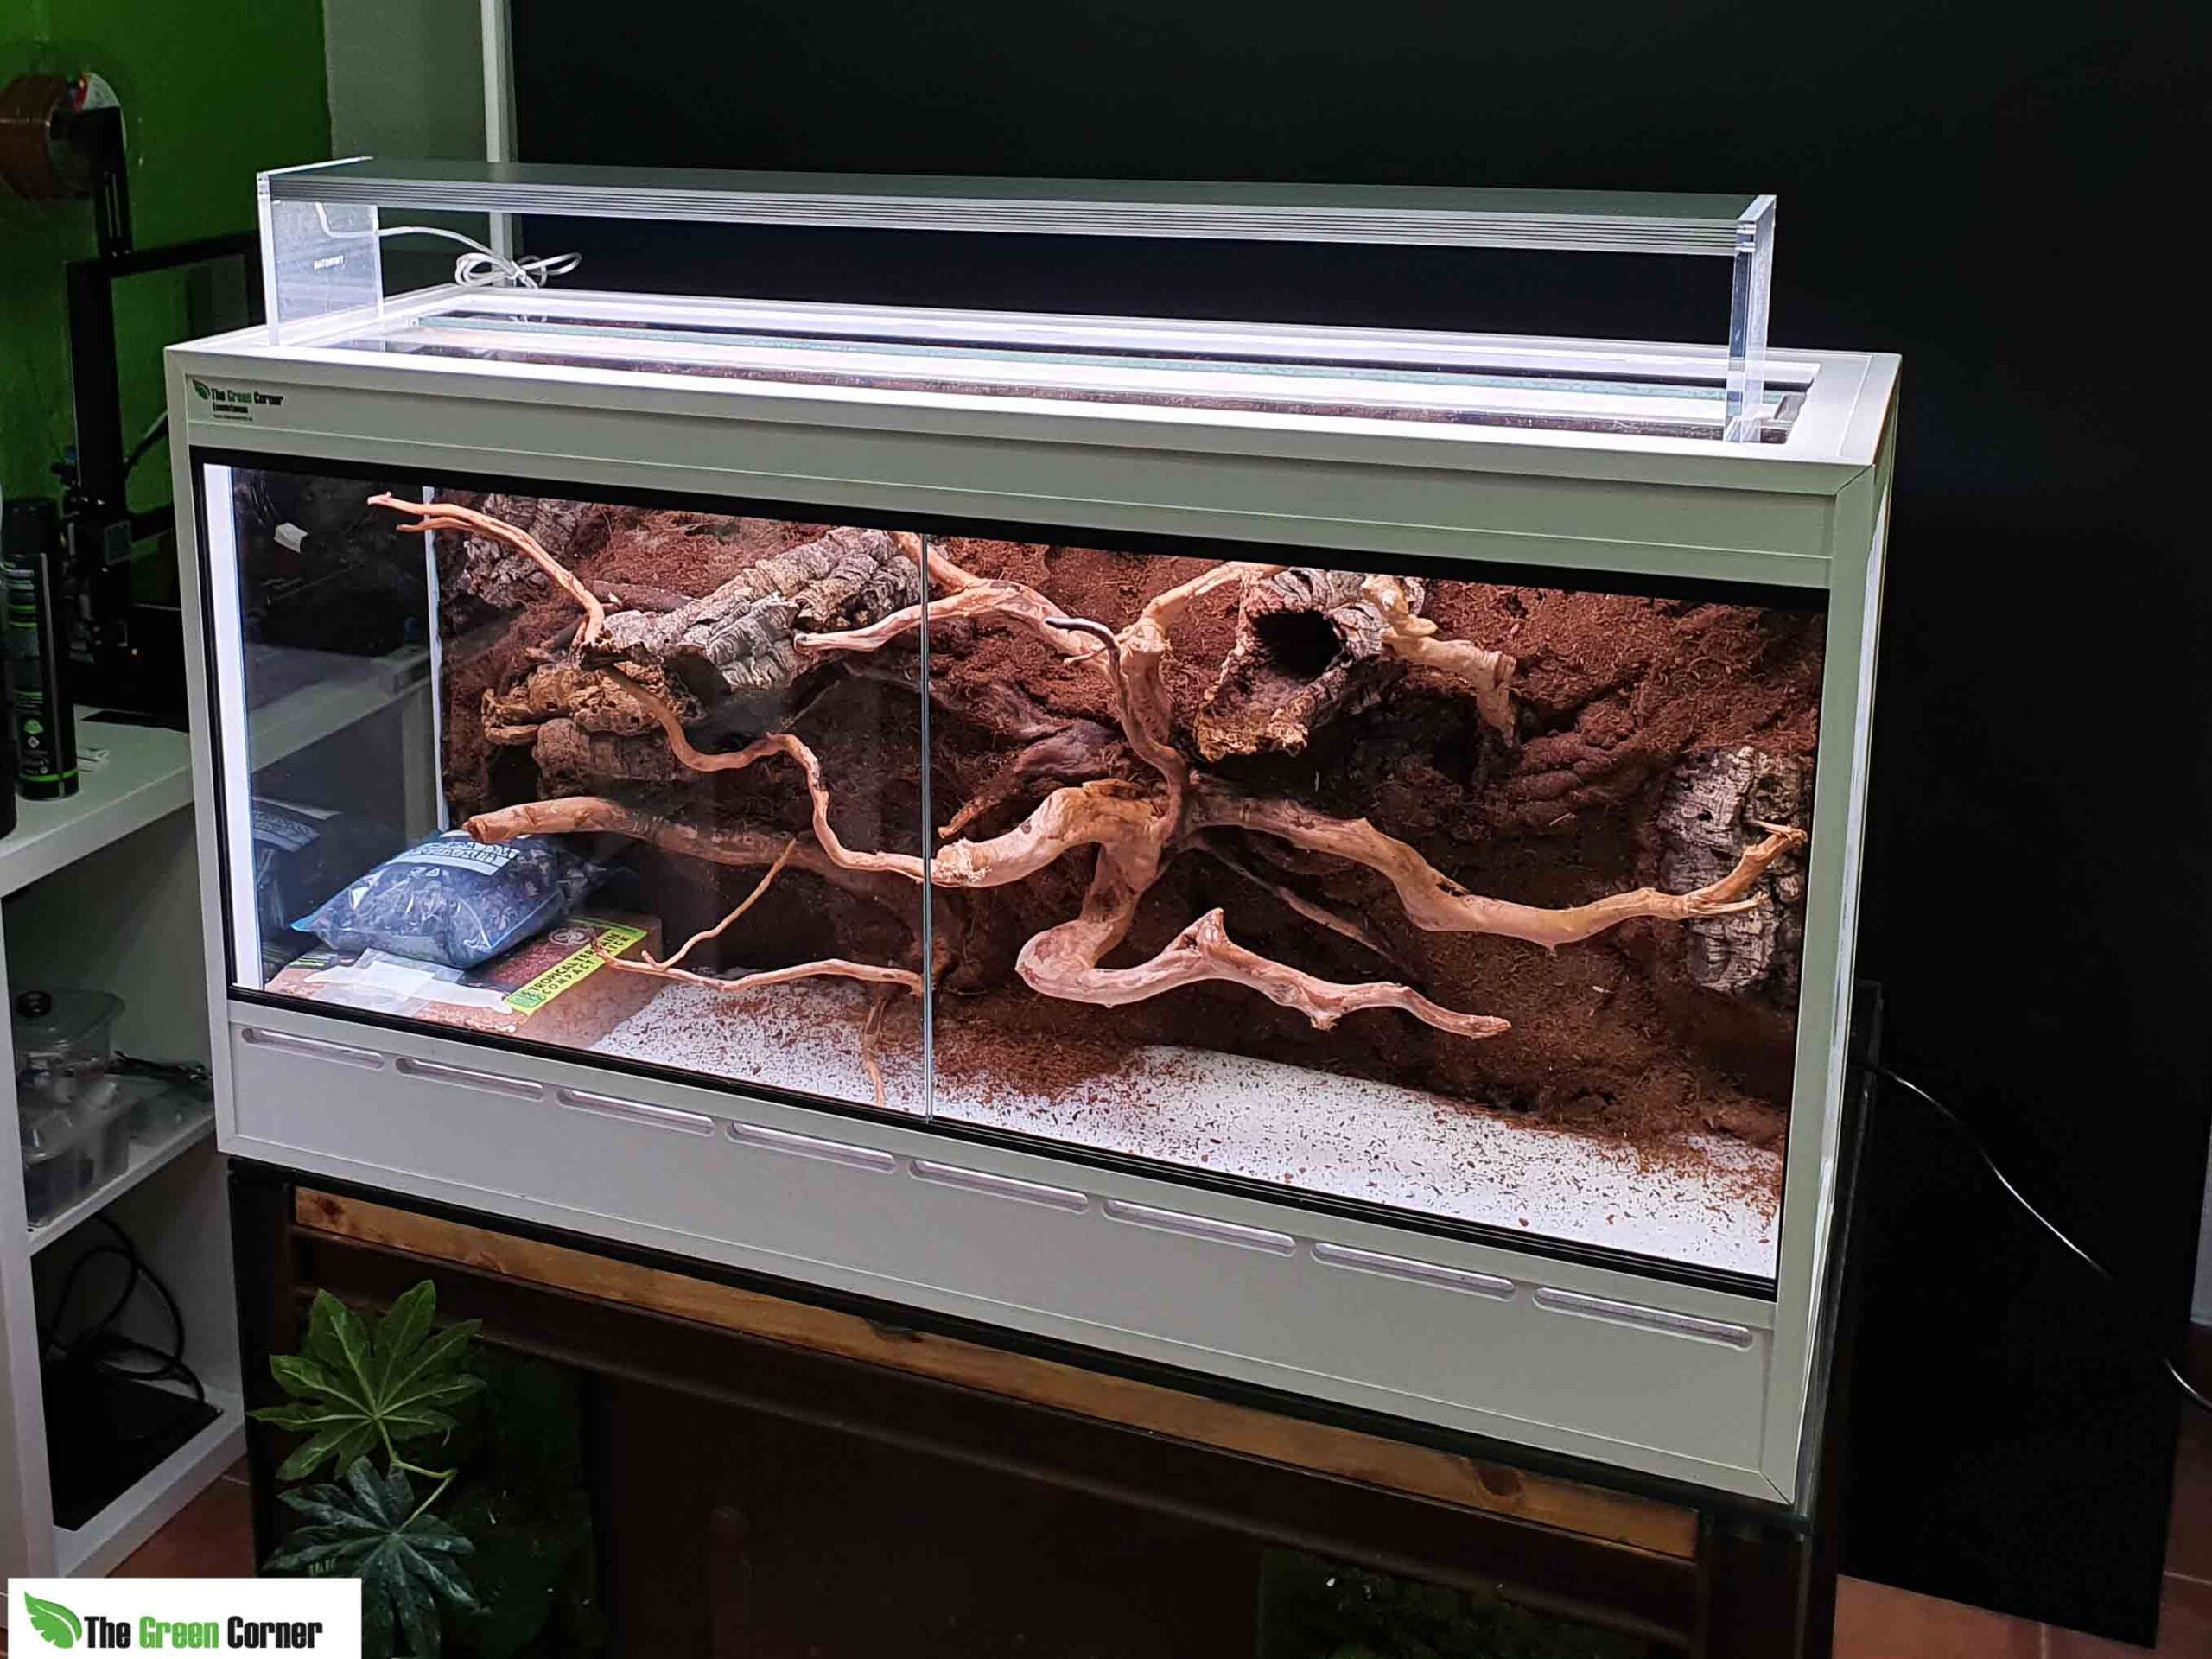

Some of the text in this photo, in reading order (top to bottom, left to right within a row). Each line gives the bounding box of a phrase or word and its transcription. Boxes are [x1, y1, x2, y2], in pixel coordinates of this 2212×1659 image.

[211, 388, 226, 401] The
[227, 389, 252, 403] Green
[527, 932, 620, 991] TROPICAL TERAIN
[542, 959, 596, 995] COMPACT
